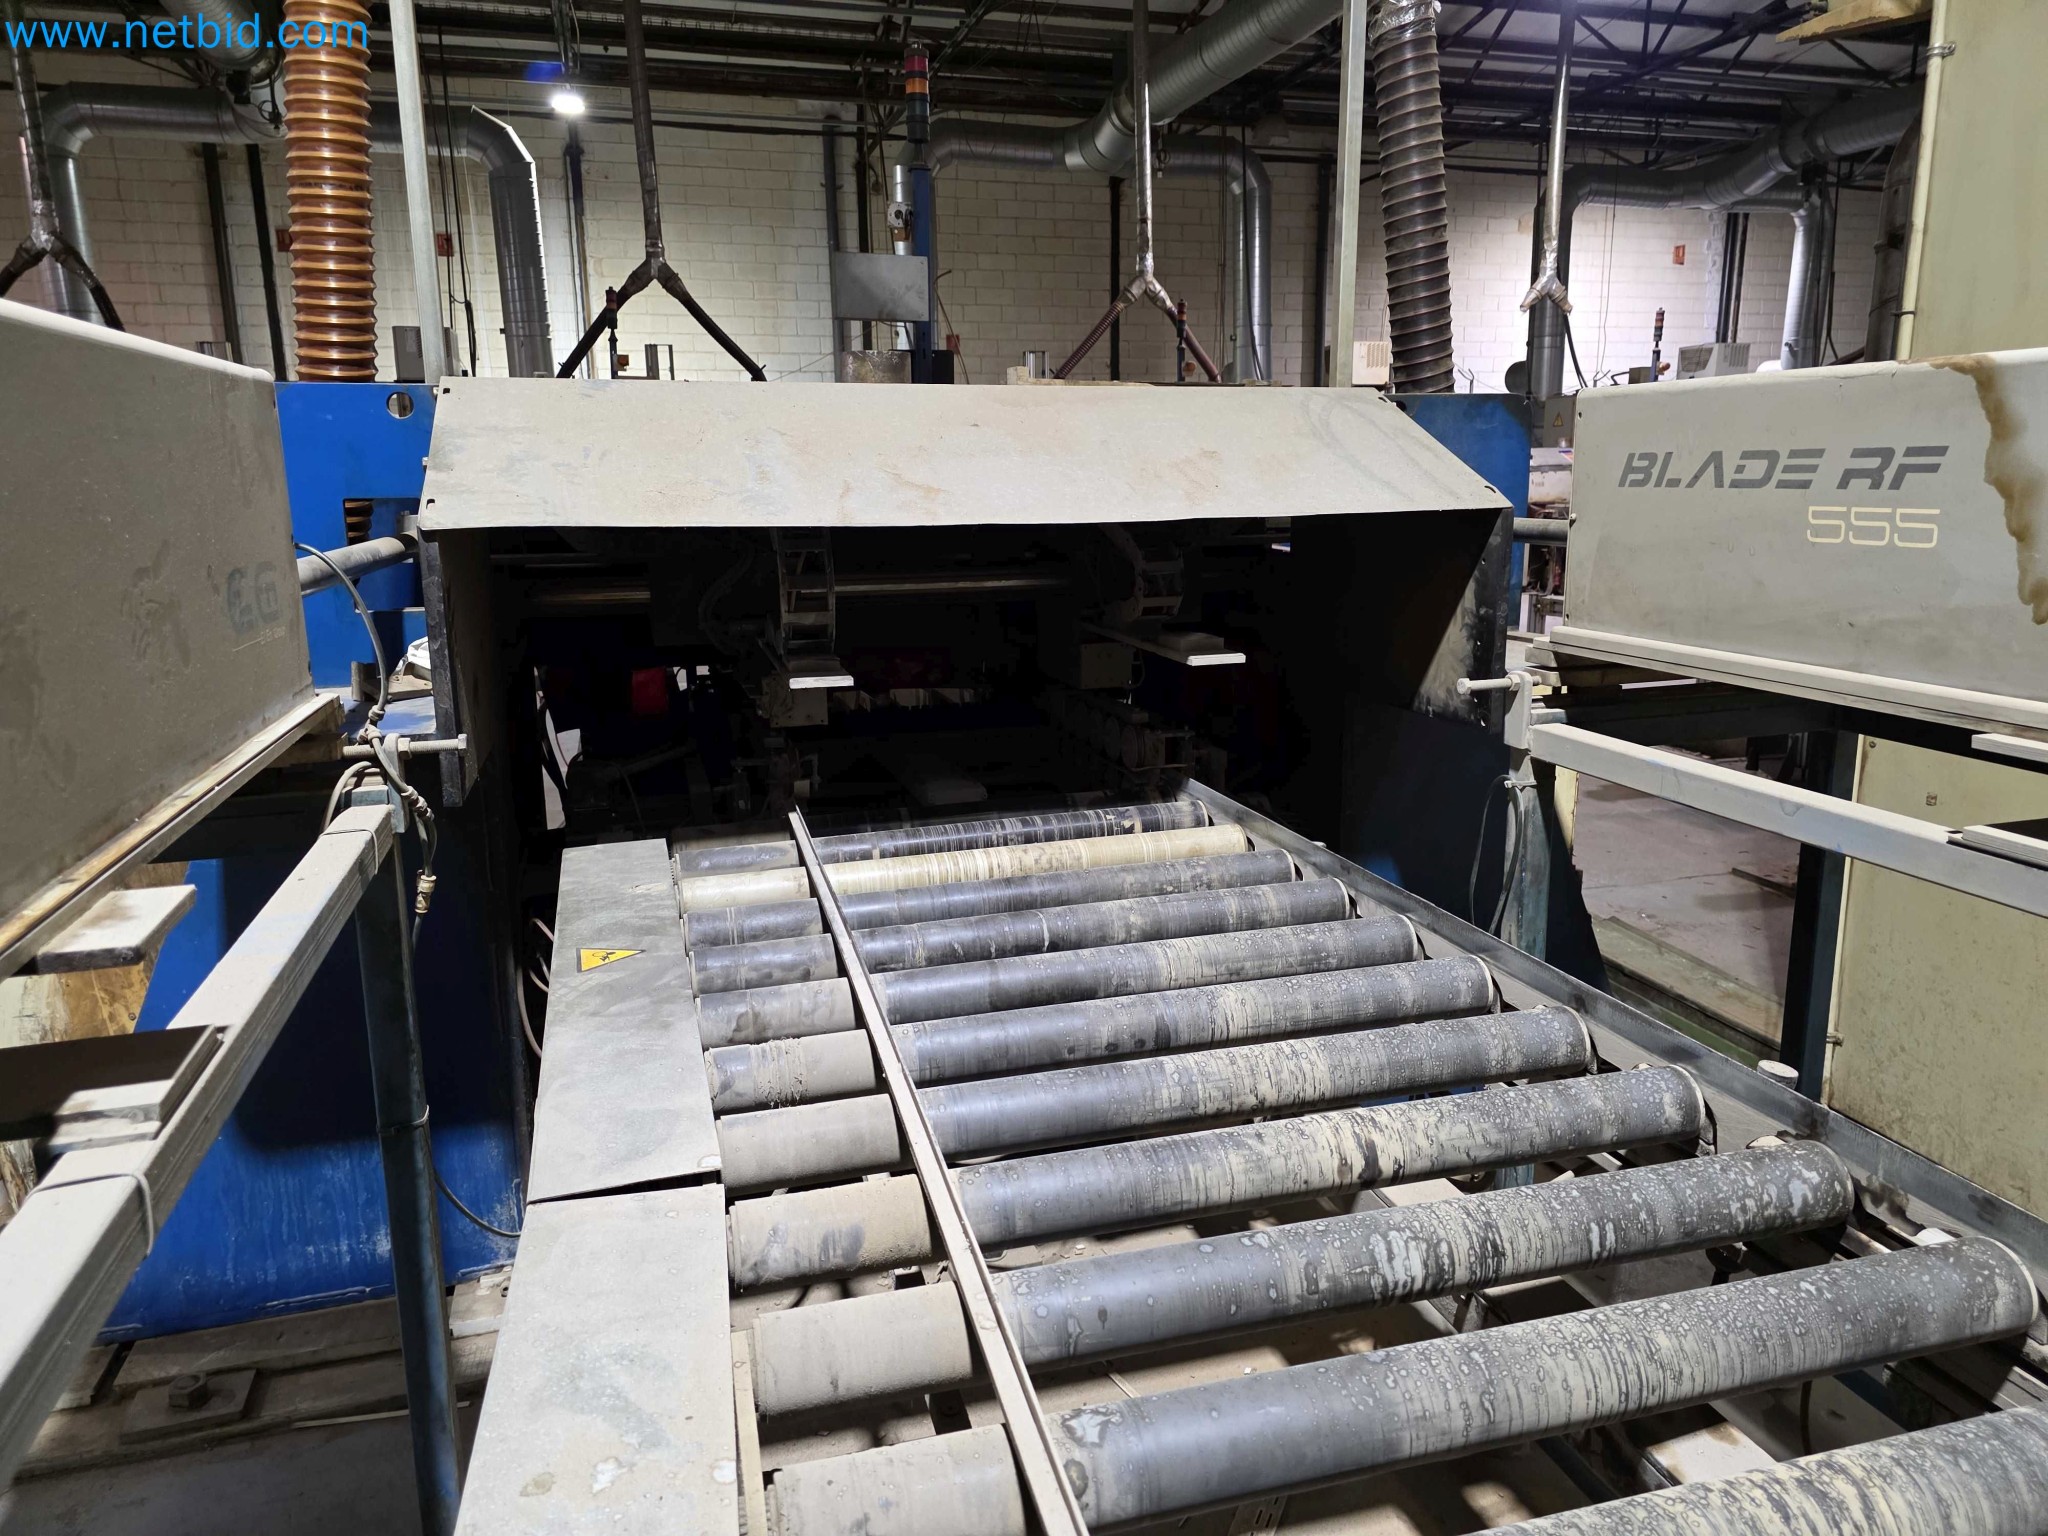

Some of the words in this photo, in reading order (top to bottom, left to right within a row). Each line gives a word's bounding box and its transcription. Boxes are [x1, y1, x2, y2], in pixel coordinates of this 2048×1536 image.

[1617, 447, 1826, 490] BLADE
[1836, 445, 1950, 491] RF
[1806, 506, 1941, 549] 555
